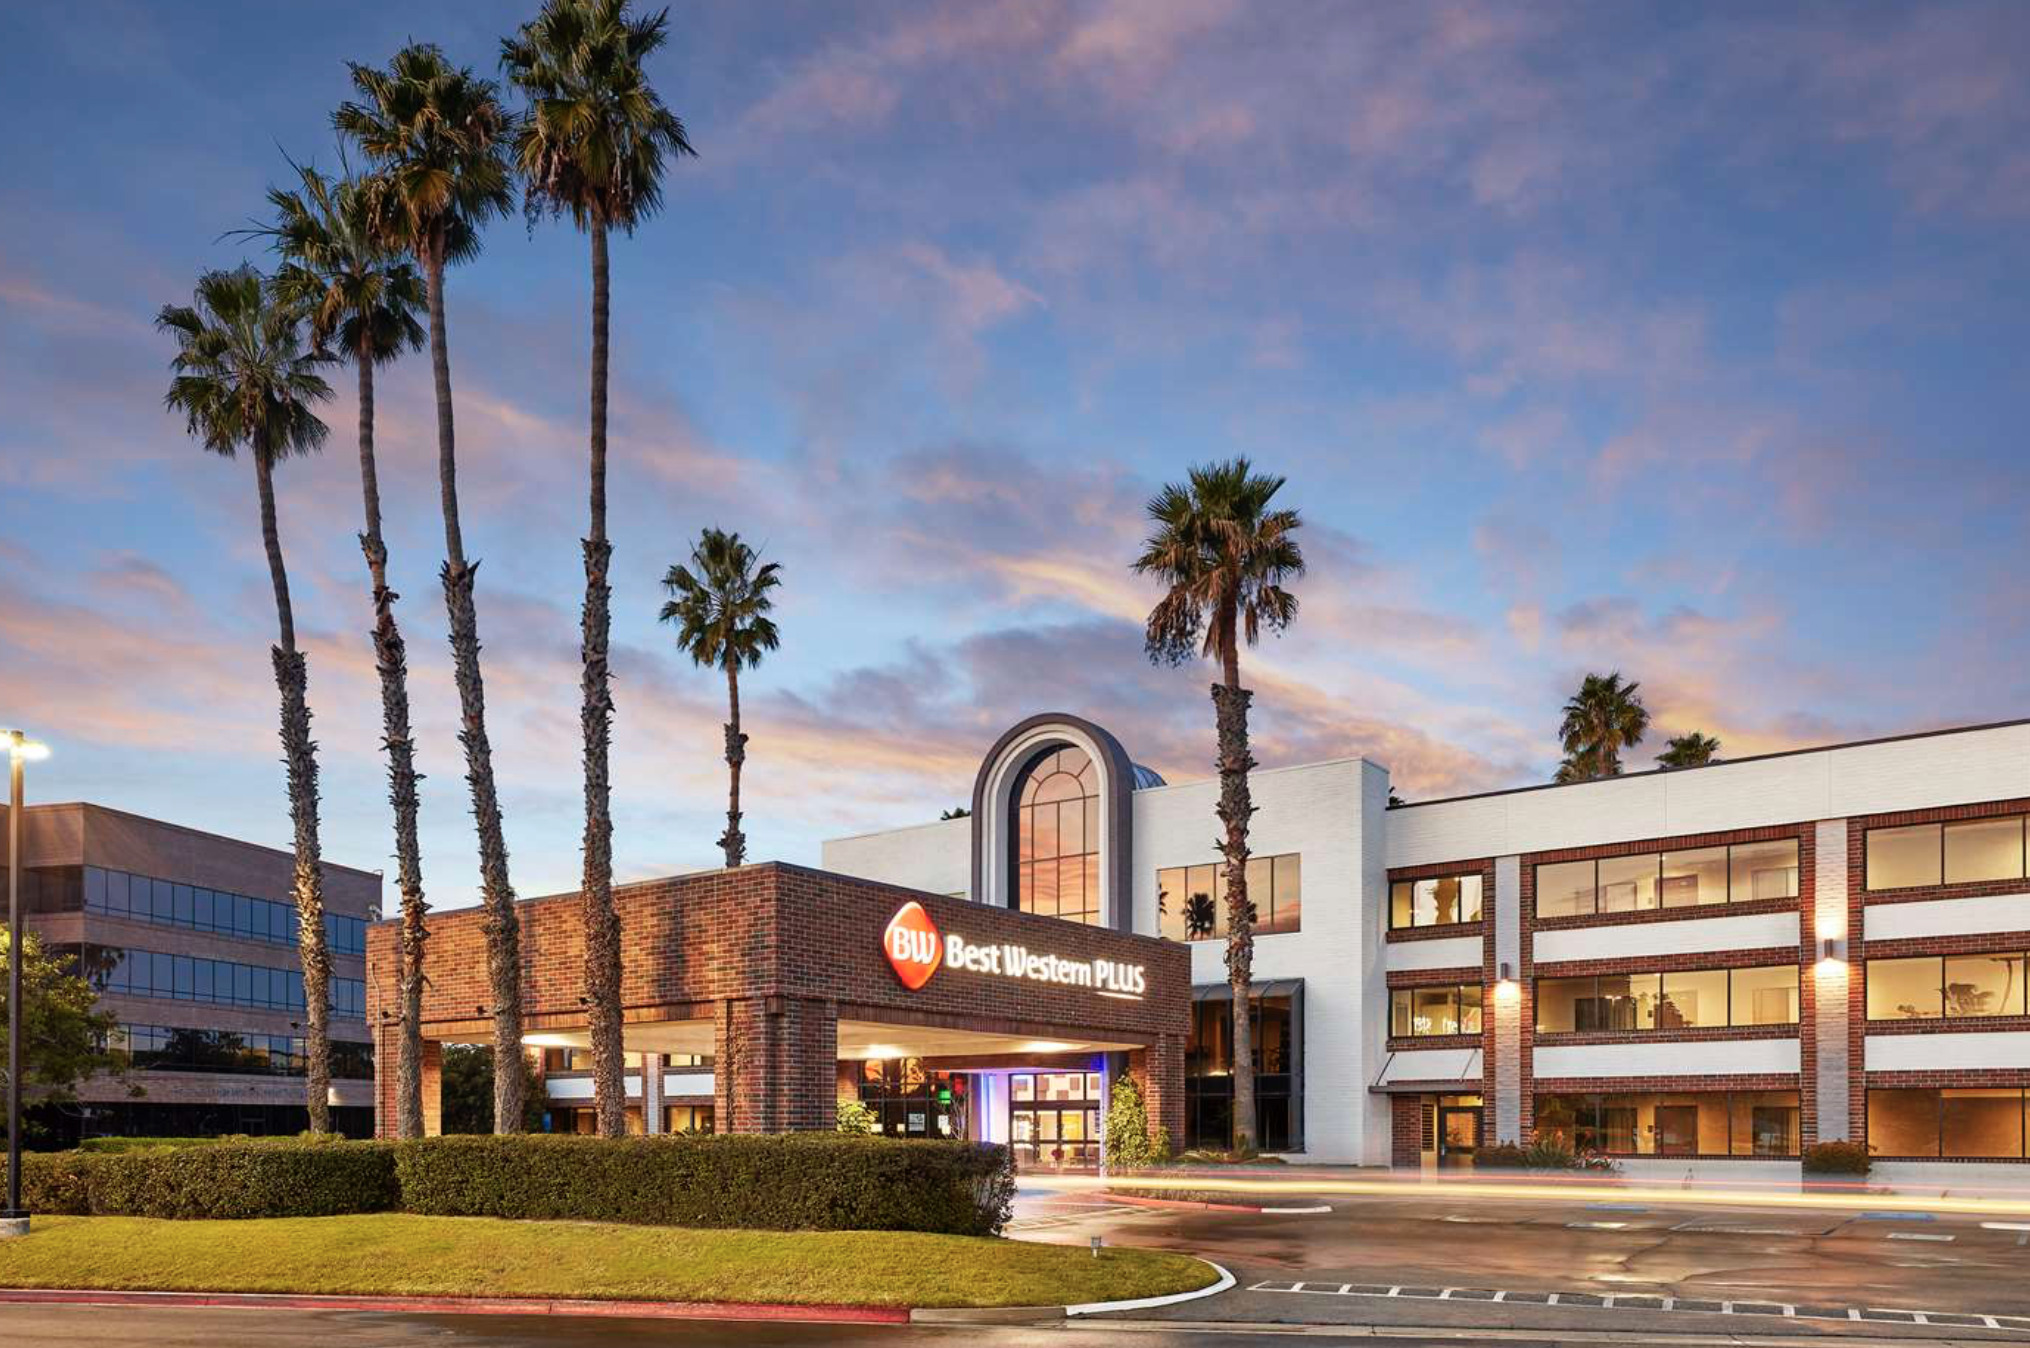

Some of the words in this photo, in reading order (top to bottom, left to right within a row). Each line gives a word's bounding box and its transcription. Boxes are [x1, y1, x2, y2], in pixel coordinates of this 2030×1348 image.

[892, 927, 935, 964] BW
[946, 935, 1001, 974] Best
[1003, 946, 1091, 986] Western
[1095, 959, 1145, 993] PLUS
